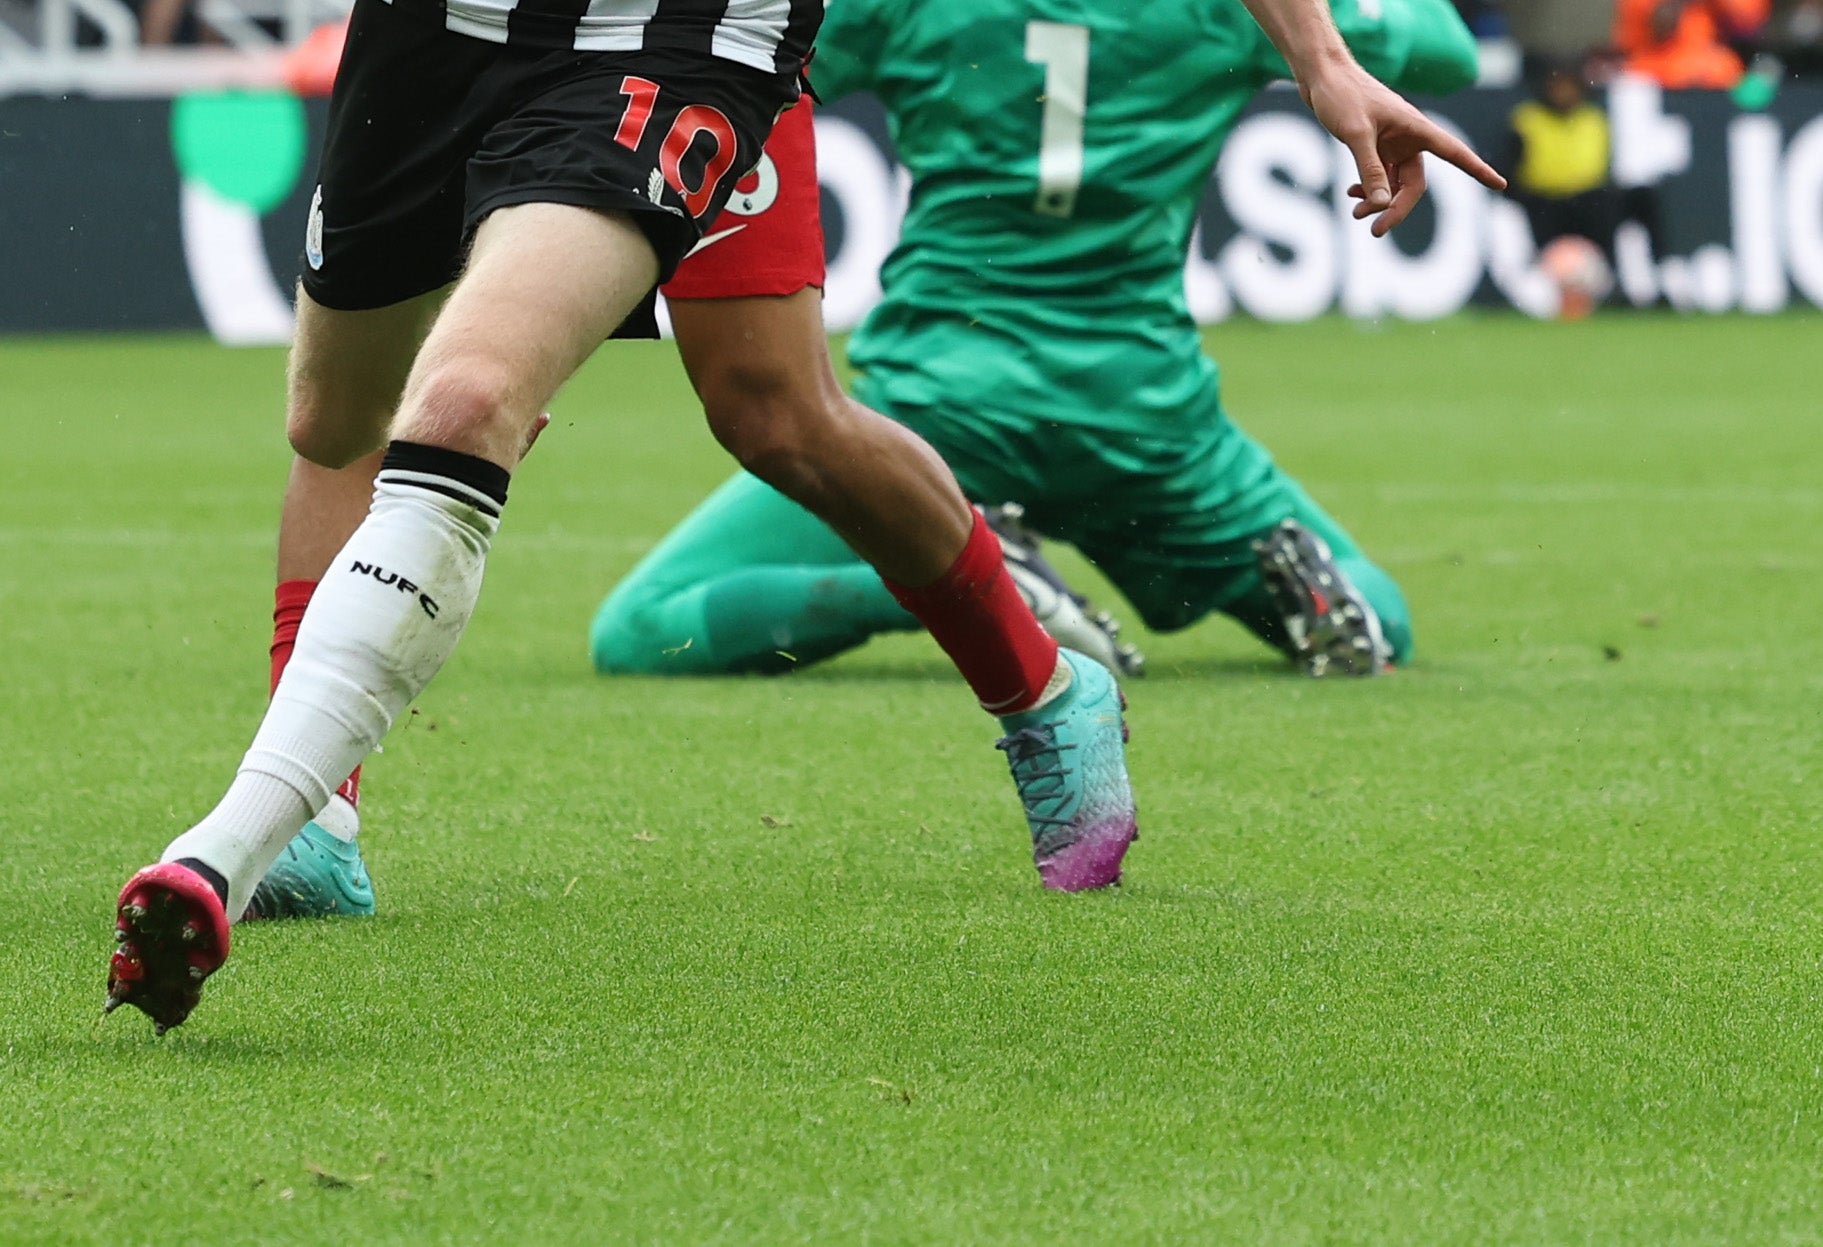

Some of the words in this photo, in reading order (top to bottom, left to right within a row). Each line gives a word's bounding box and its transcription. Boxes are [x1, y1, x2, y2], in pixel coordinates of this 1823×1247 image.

[614, 75, 738, 219] 10
[1024, 19, 1090, 219] 1
[350, 560, 439, 620] NUFC
